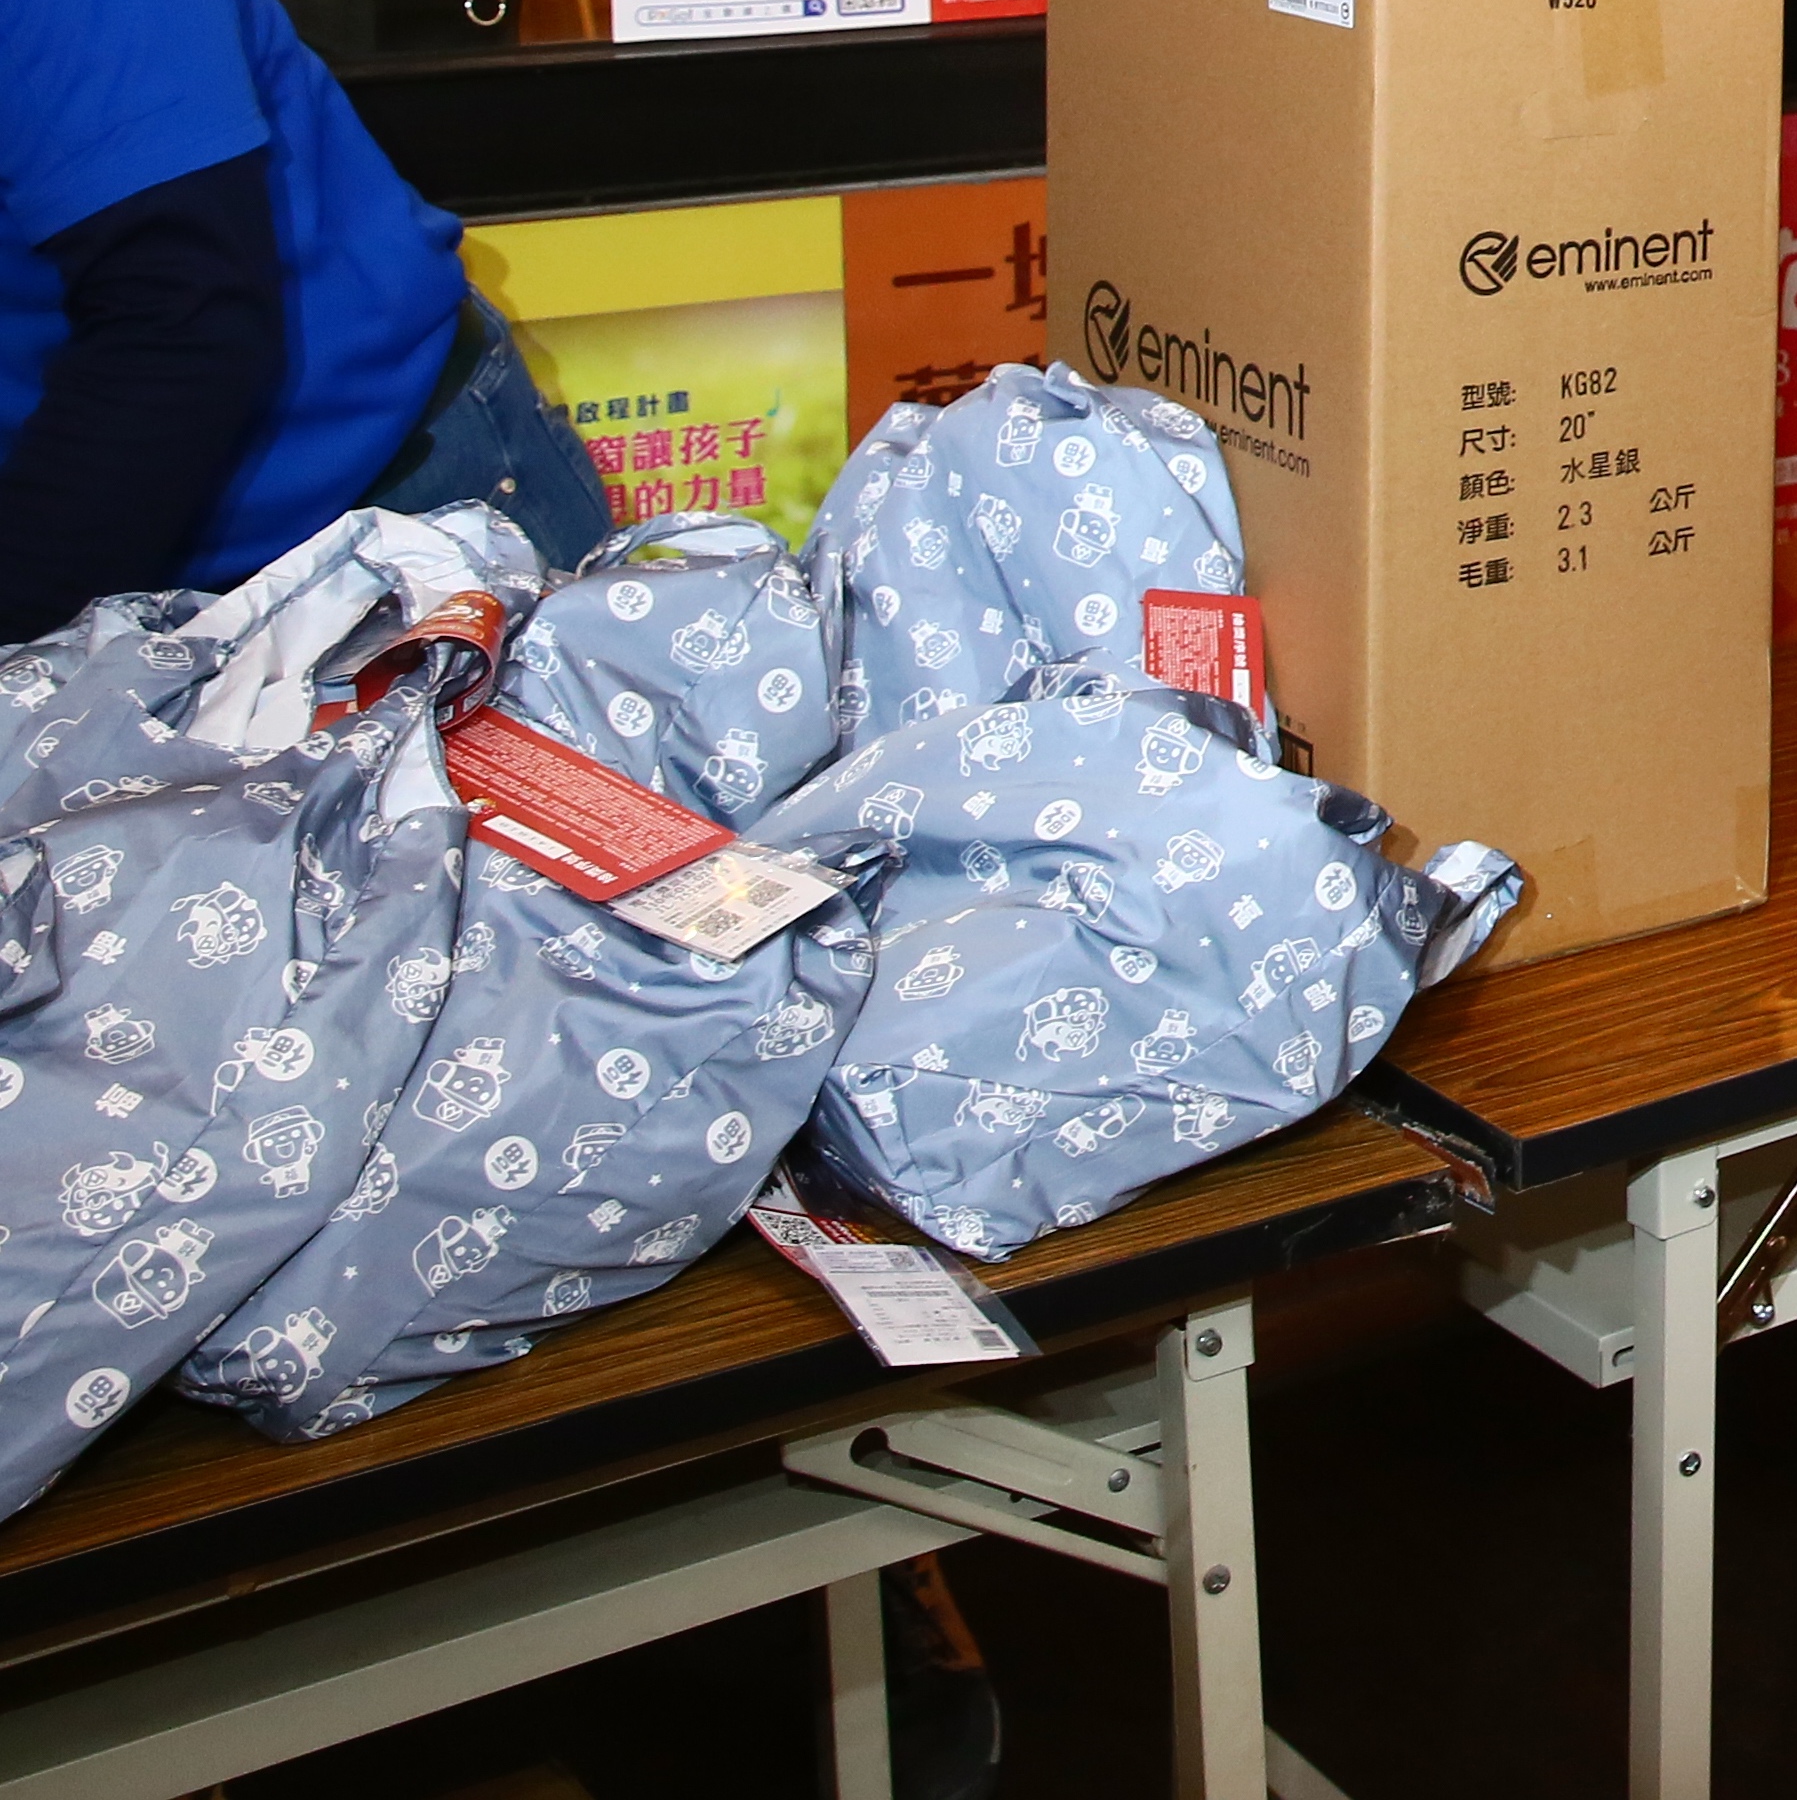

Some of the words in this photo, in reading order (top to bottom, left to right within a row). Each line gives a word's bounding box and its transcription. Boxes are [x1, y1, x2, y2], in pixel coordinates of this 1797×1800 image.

[1526, 219, 1713, 280] eminent
[1585, 267, 1712, 293] www.eminent.com
[1137, 324, 1310, 441] eminent
[1560, 367, 1618, 400] KG82
[1560, 448, 1641, 485] 水星銀
[1557, 502, 1593, 531] 2.3
[1649, 484, 1696, 514] 公斤
[1557, 545, 1588, 574] 3.1
[1648, 526, 1696, 556] 公斤
